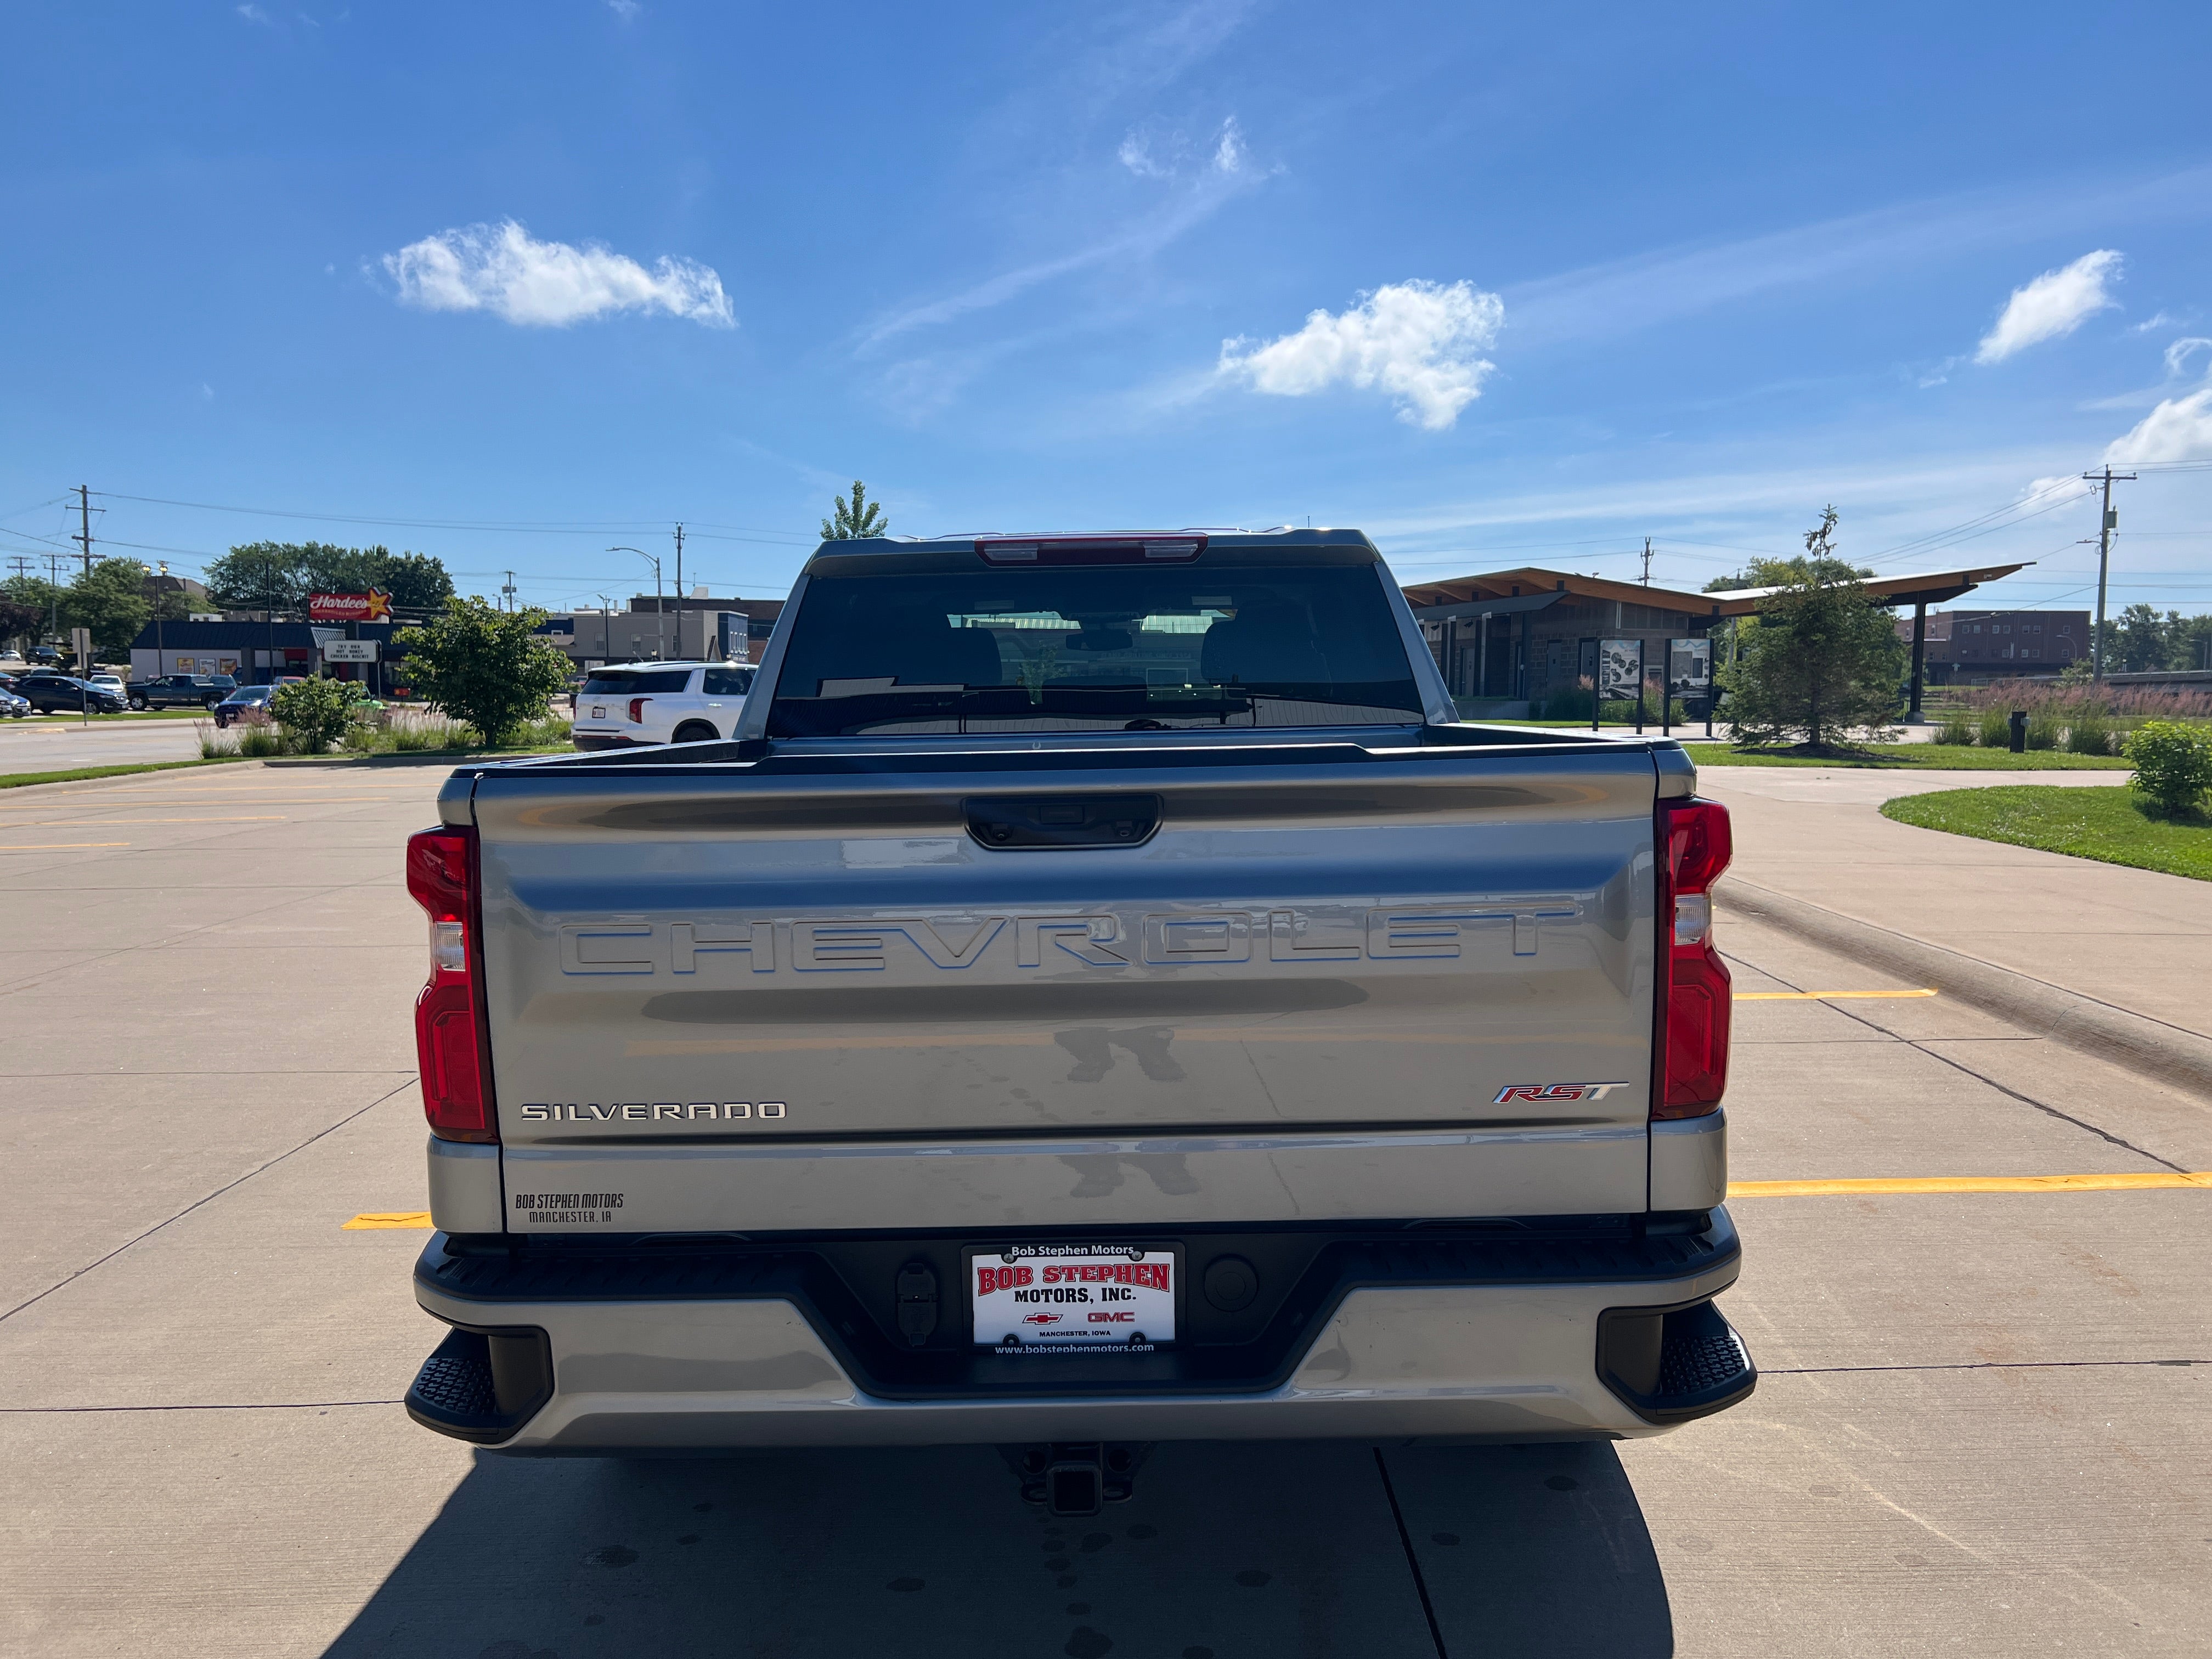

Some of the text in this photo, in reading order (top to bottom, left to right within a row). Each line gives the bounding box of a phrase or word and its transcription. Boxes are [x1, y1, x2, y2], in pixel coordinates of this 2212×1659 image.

[310, 595, 368, 610] Hardee's
[560, 902, 1584, 975] CHEVROLET
[1492, 1081, 1630, 1104] RST
[521, 1101, 787, 1121] SILVERADO
[515, 1193, 624, 1209] BOB STEPHEN MOTORS
[529, 1211, 611, 1223] MANCHESTER, IA
[1012, 1245, 1134, 1257] Bob Stephen Motors
[977, 1263, 1171, 1296] BOB STEPHEN
[1014, 1288, 1137, 1304] MOTORS, INC.
[1087, 1312, 1135, 1323] GMC
[995, 1344, 1154, 1354] www.bobstephenmotors.com
